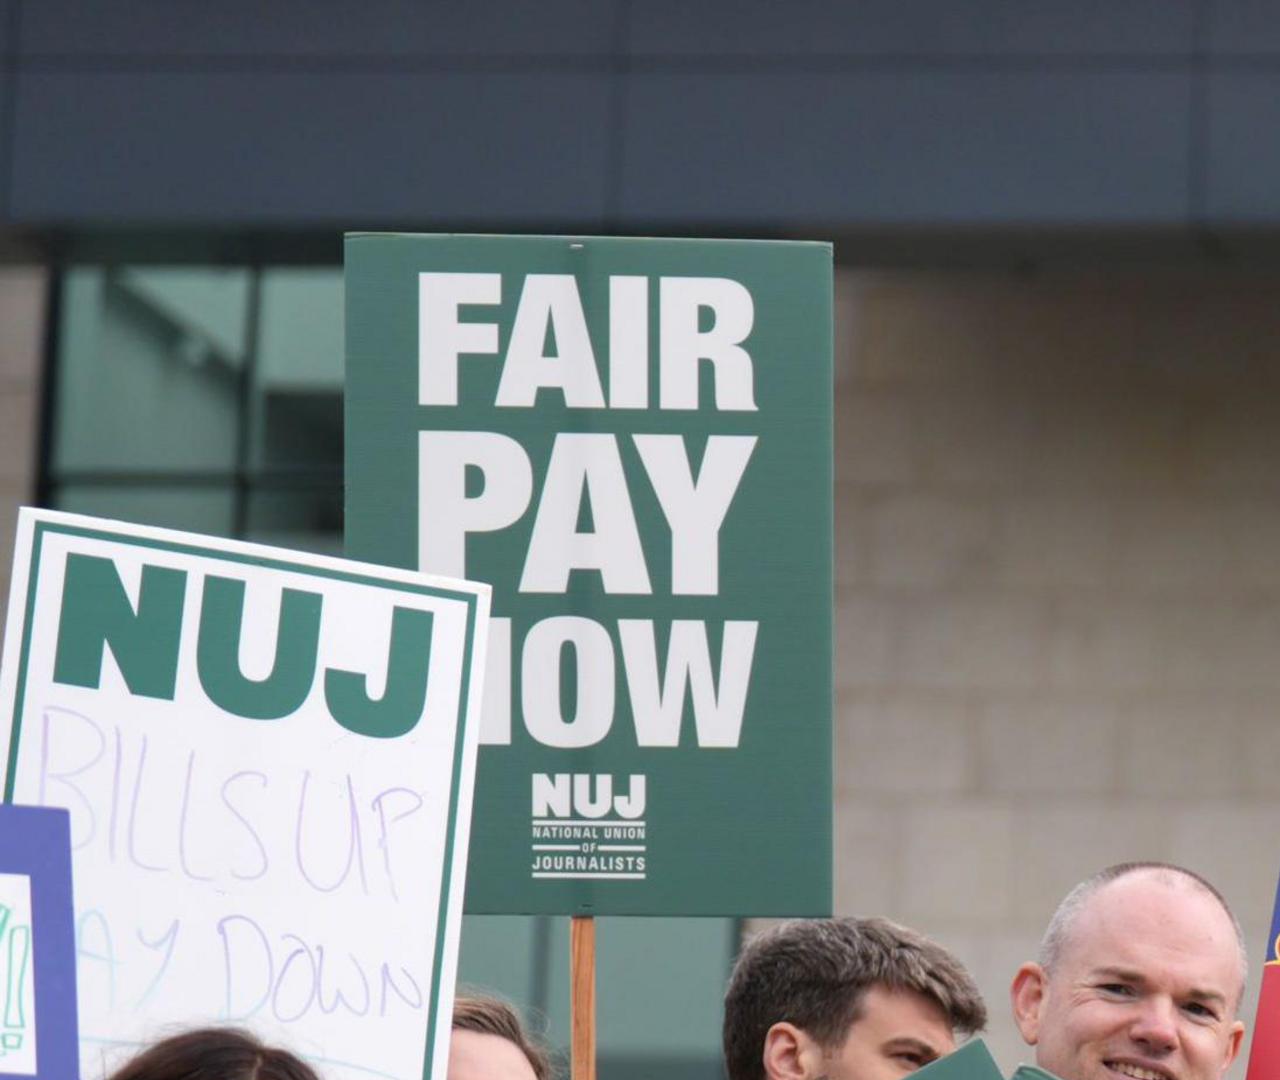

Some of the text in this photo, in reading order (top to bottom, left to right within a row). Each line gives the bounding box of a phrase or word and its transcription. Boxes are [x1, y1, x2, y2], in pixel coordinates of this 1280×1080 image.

[418, 272, 759, 412] FAIR
[418, 429, 759, 596] PAY
[53, 551, 434, 740] NUJ
[39, 705, 425, 903] BILLS UP
[531, 772, 646, 819] NUJ
[532, 826, 646, 839] NATIONAL UNION
[581, 842, 597, 853] OF
[532, 856, 646, 871] JOURNALISTS
[76, 907, 180, 1011] AY
[217, 914, 424, 1022] DOWN
